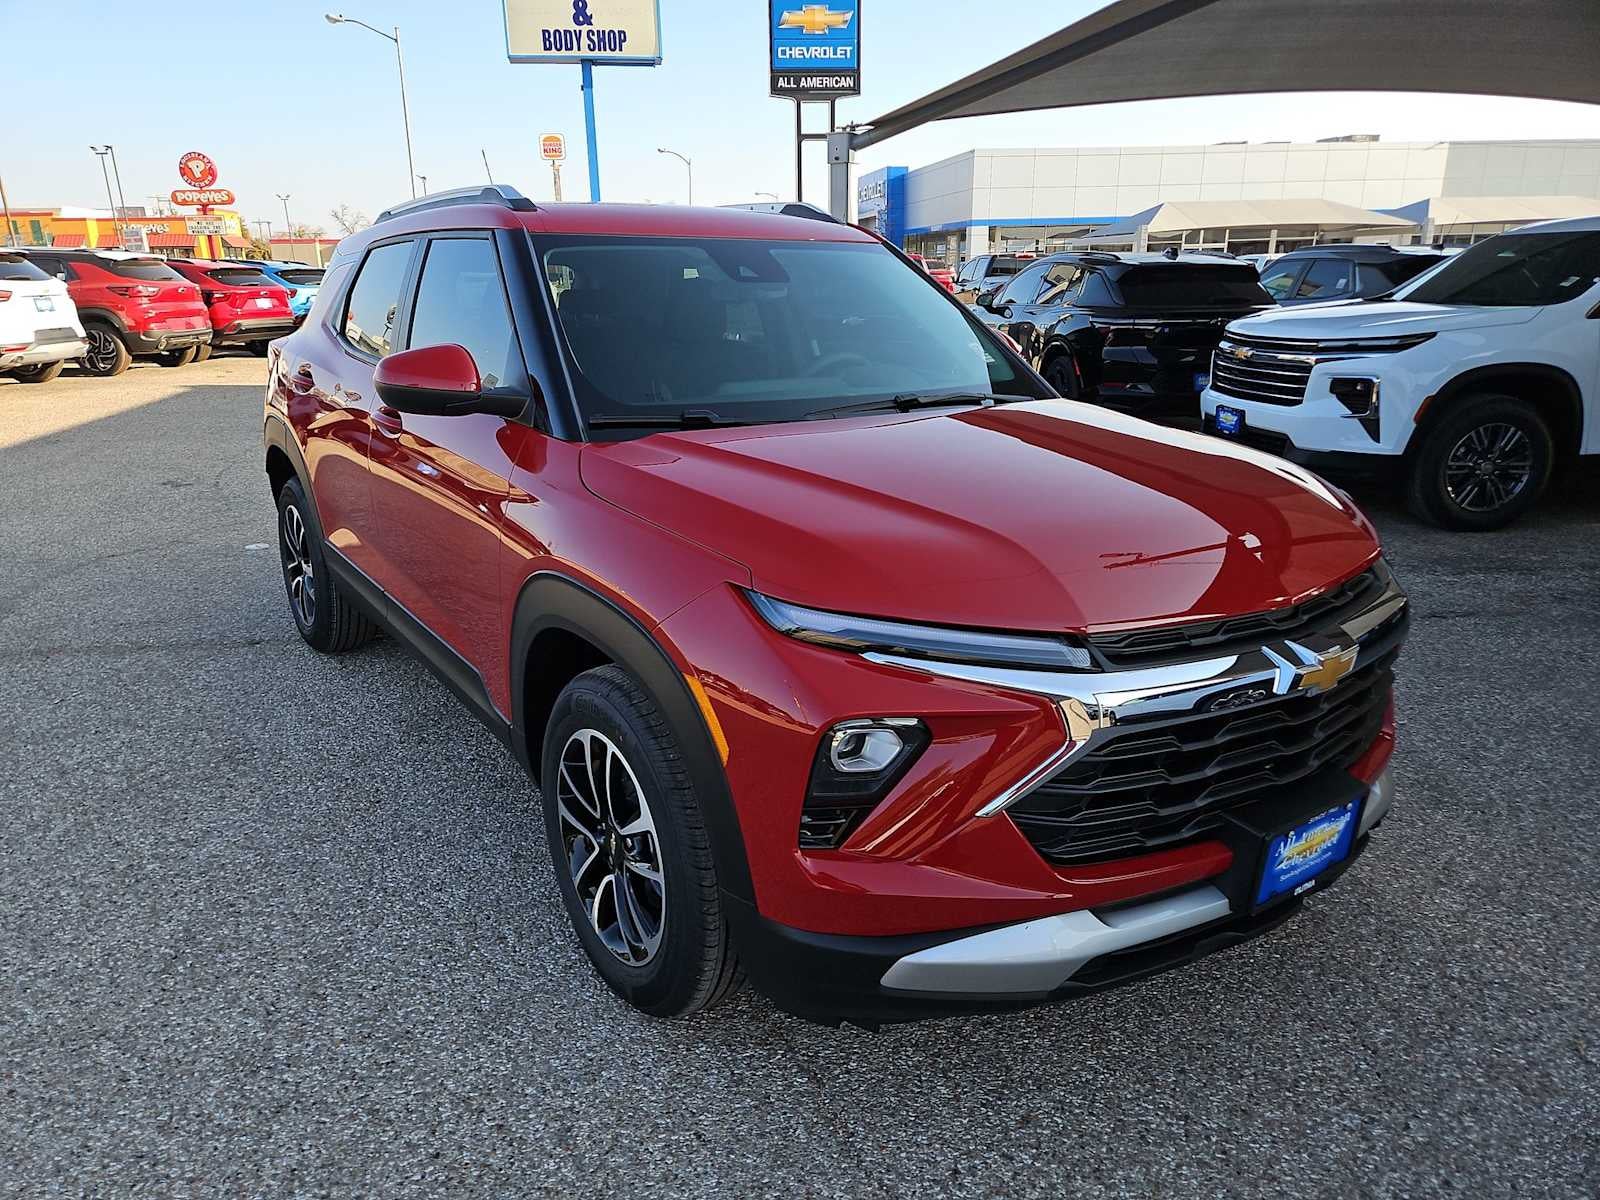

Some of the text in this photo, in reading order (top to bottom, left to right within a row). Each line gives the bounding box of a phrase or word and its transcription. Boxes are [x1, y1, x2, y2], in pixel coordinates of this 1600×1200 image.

[572, 0, 593, 26] &
[541, 29, 627, 52] BODY SHOP
[777, 46, 853, 59] CHEVROLET
[777, 76, 854, 88] ALL AMERICAN
